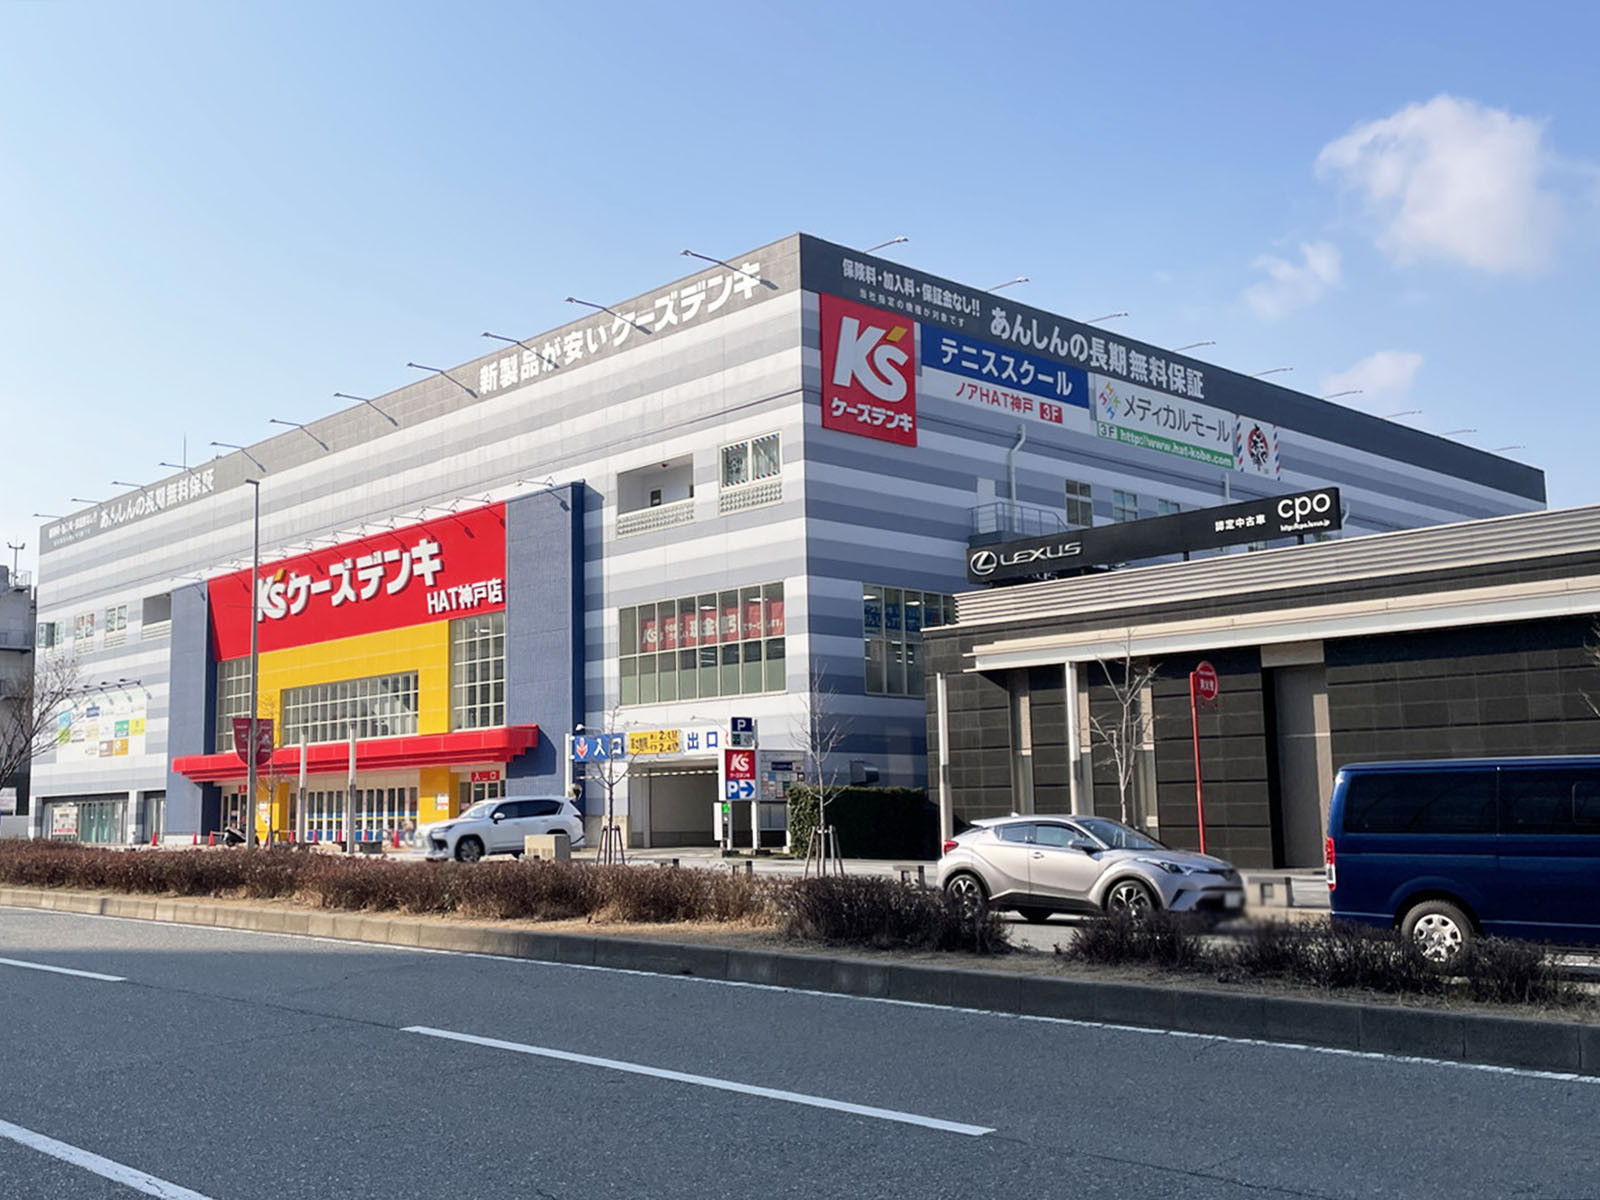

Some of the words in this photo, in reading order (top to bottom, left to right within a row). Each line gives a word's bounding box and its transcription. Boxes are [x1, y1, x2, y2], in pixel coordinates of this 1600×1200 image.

[480, 262, 761, 394] 新製品が安いケーズデンキ
[832, 316, 909, 402] K's
[941, 338, 1072, 396] テニススクール
[991, 307, 1204, 399] あんしんの長期無料保証
[831, 397, 913, 432] ケーズデンキ
[956, 382, 1033, 413] ノアHAT神戸
[1043, 404, 1060, 422] 3F
[1124, 394, 1230, 442] メディカルモール
[1100, 425, 1115, 438] 3F
[1277, 493, 1331, 522] cpo
[1001, 541, 1081, 566] LEXUS
[287, 538, 443, 615] ケーズデンキ
[427, 578, 503, 614] HAT神戸店
[688, 731, 718, 749] 出口
[737, 719, 746, 731] P
[727, 781, 738, 798] P
